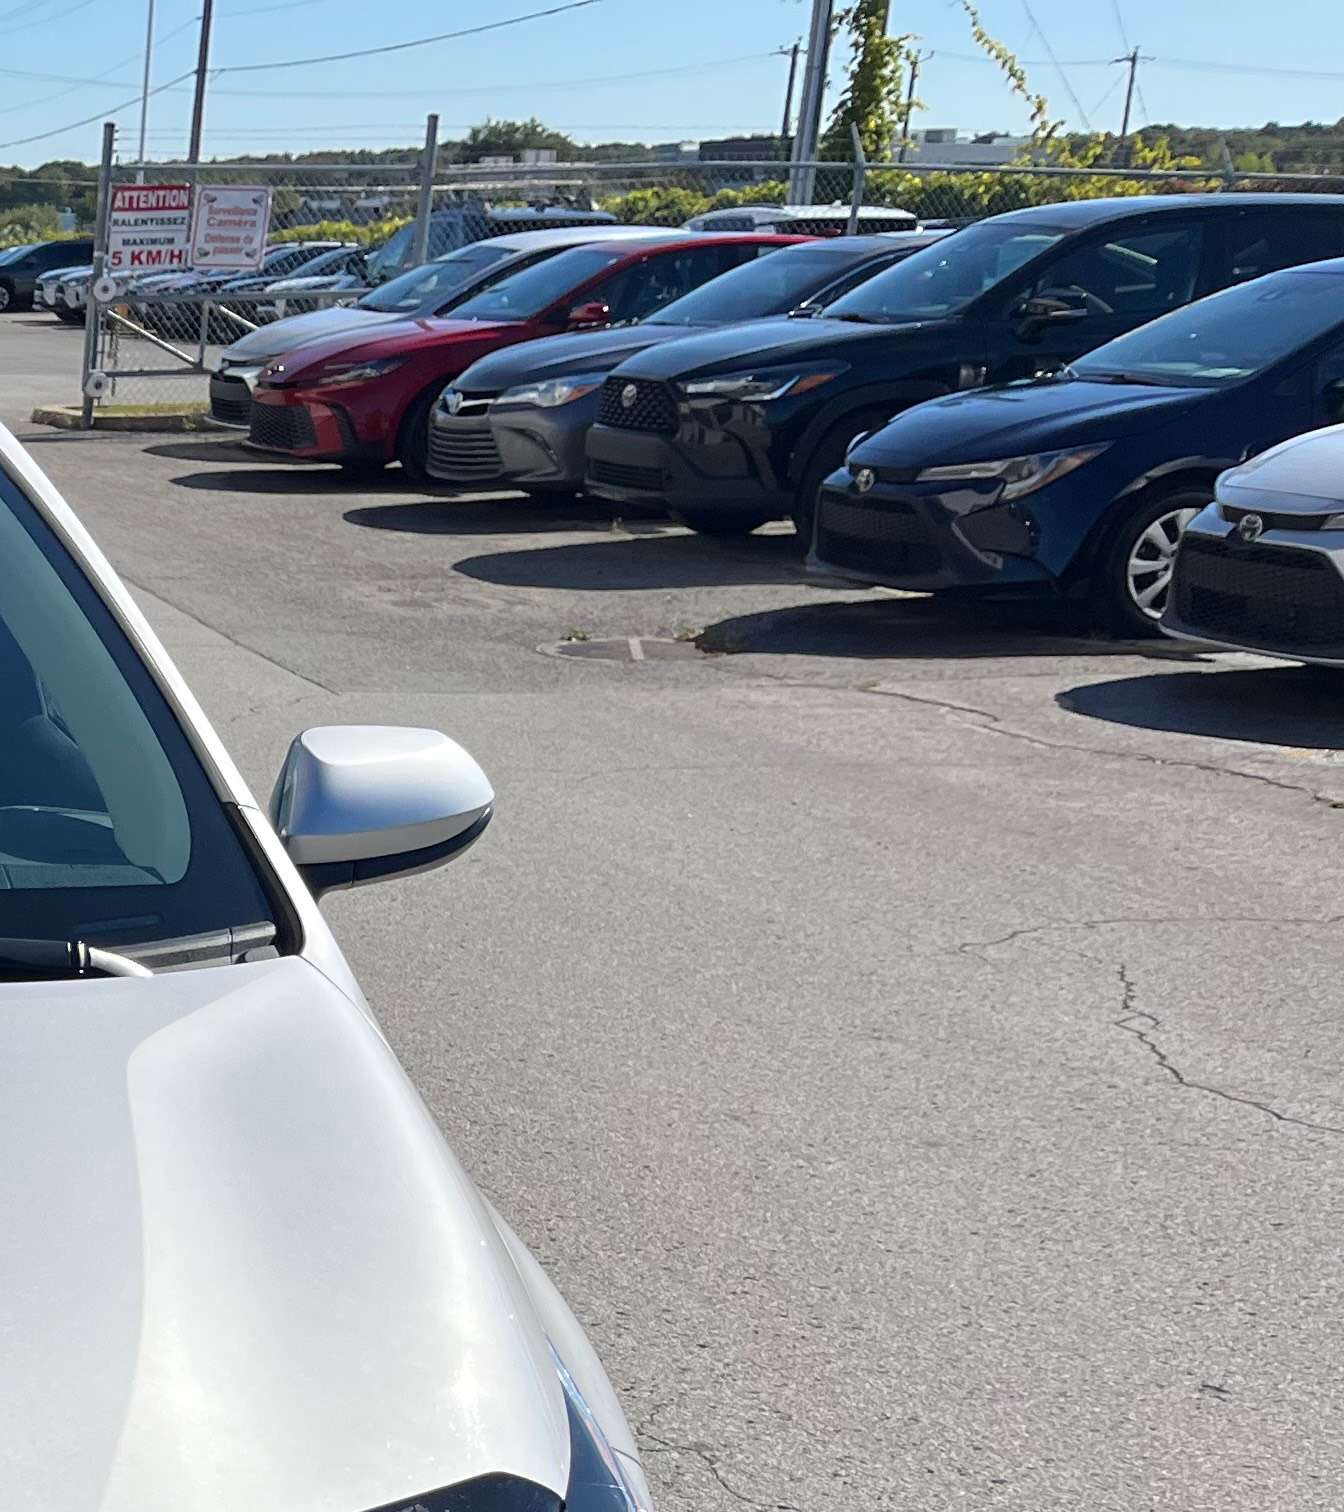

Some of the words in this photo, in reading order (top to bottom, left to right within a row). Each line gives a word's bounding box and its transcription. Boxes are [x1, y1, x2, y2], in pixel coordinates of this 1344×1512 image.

[113, 189, 188, 209] ATTENTION
[112, 216, 186, 226] RALENTISSEZ
[122, 237, 175, 246] MAXIMUM
[111, 250, 123, 266] 5
[130, 249, 183, 265] KM/H
